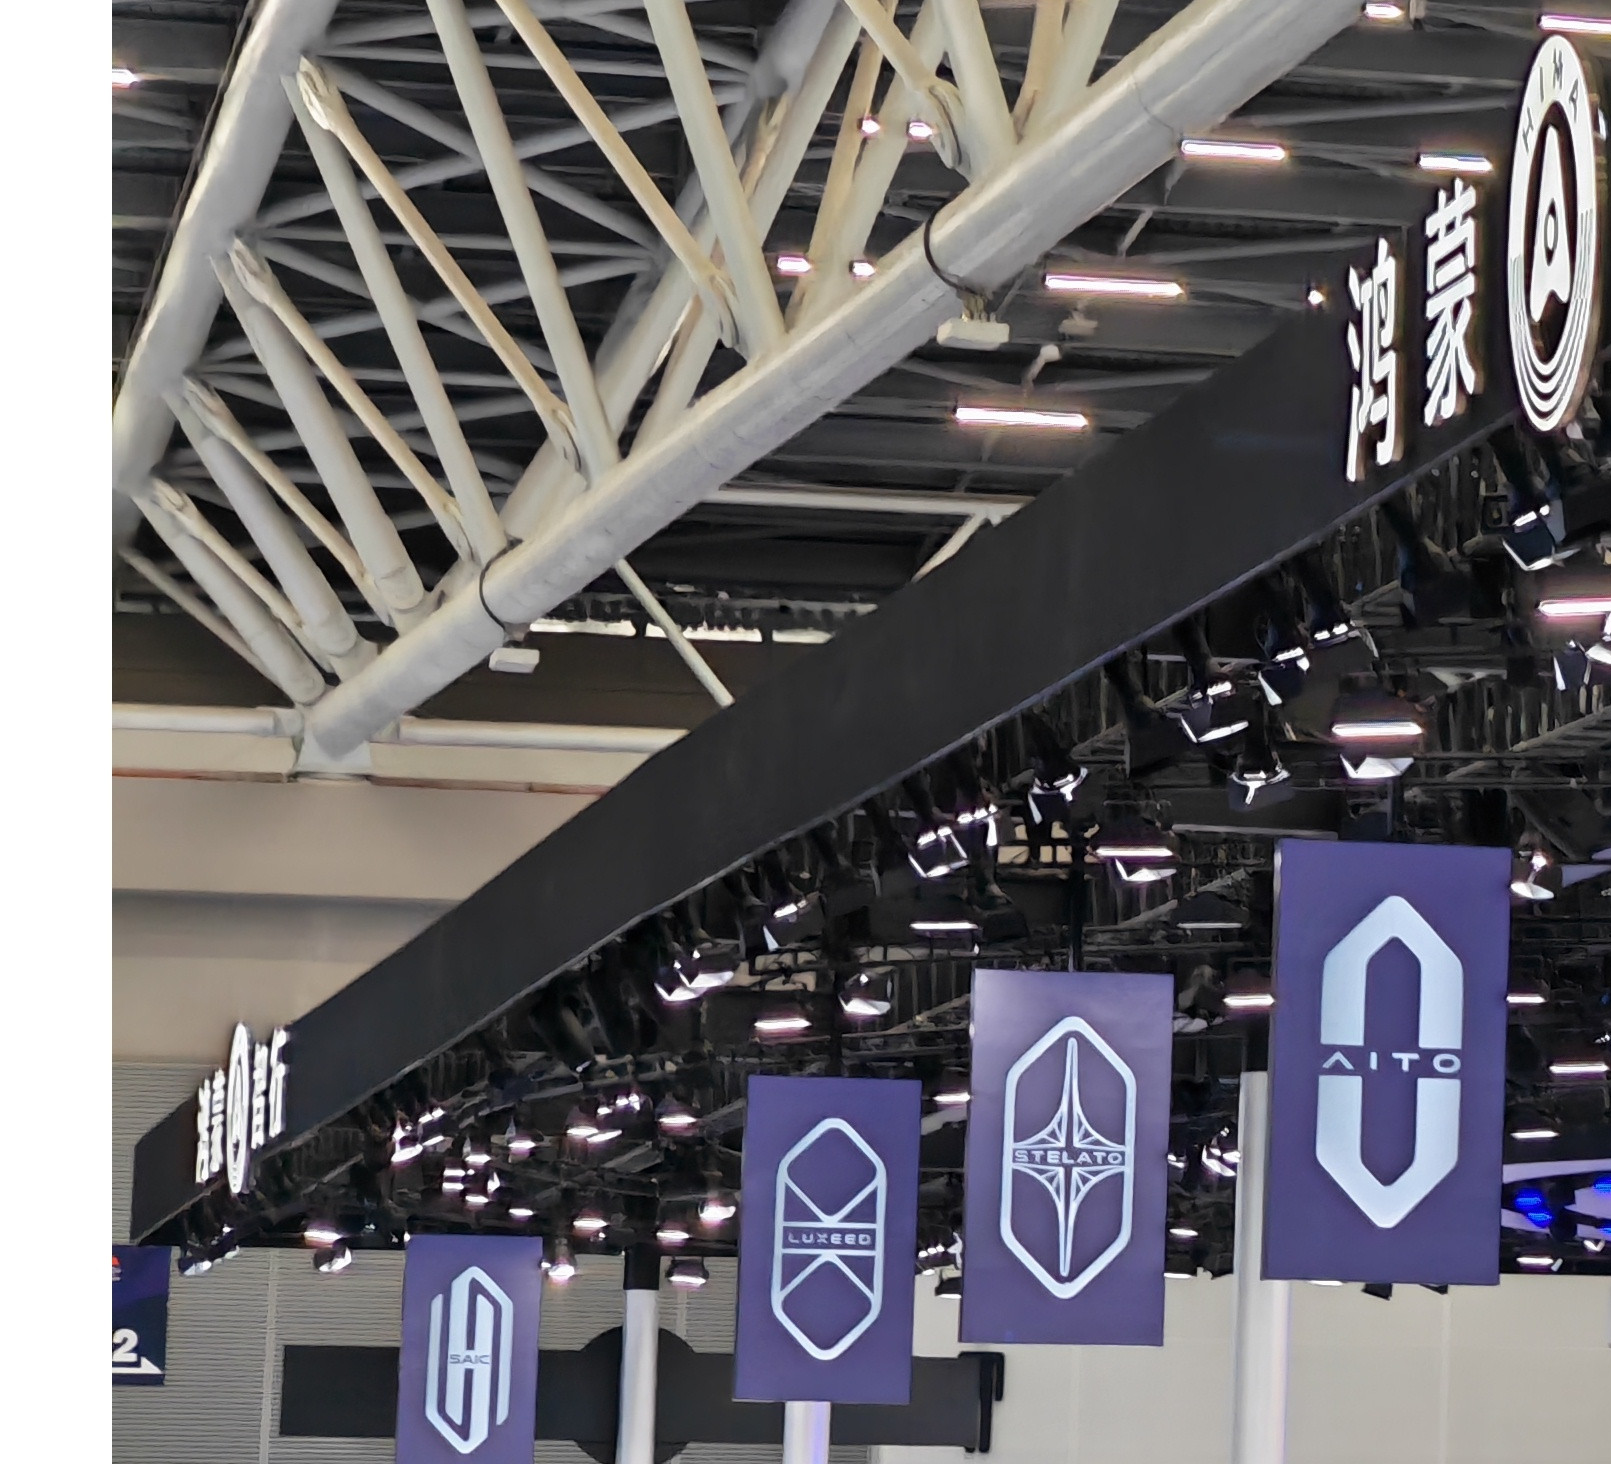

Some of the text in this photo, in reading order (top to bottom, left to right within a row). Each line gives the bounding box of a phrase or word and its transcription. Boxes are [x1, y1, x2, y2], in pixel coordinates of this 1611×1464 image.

[1346, 177, 1477, 482] 鸿蒙
[1322, 1050, 1462, 1074] AITO
[1013, 1147, 1125, 1167] STELATO
[787, 1232, 872, 1246] LUXEED
